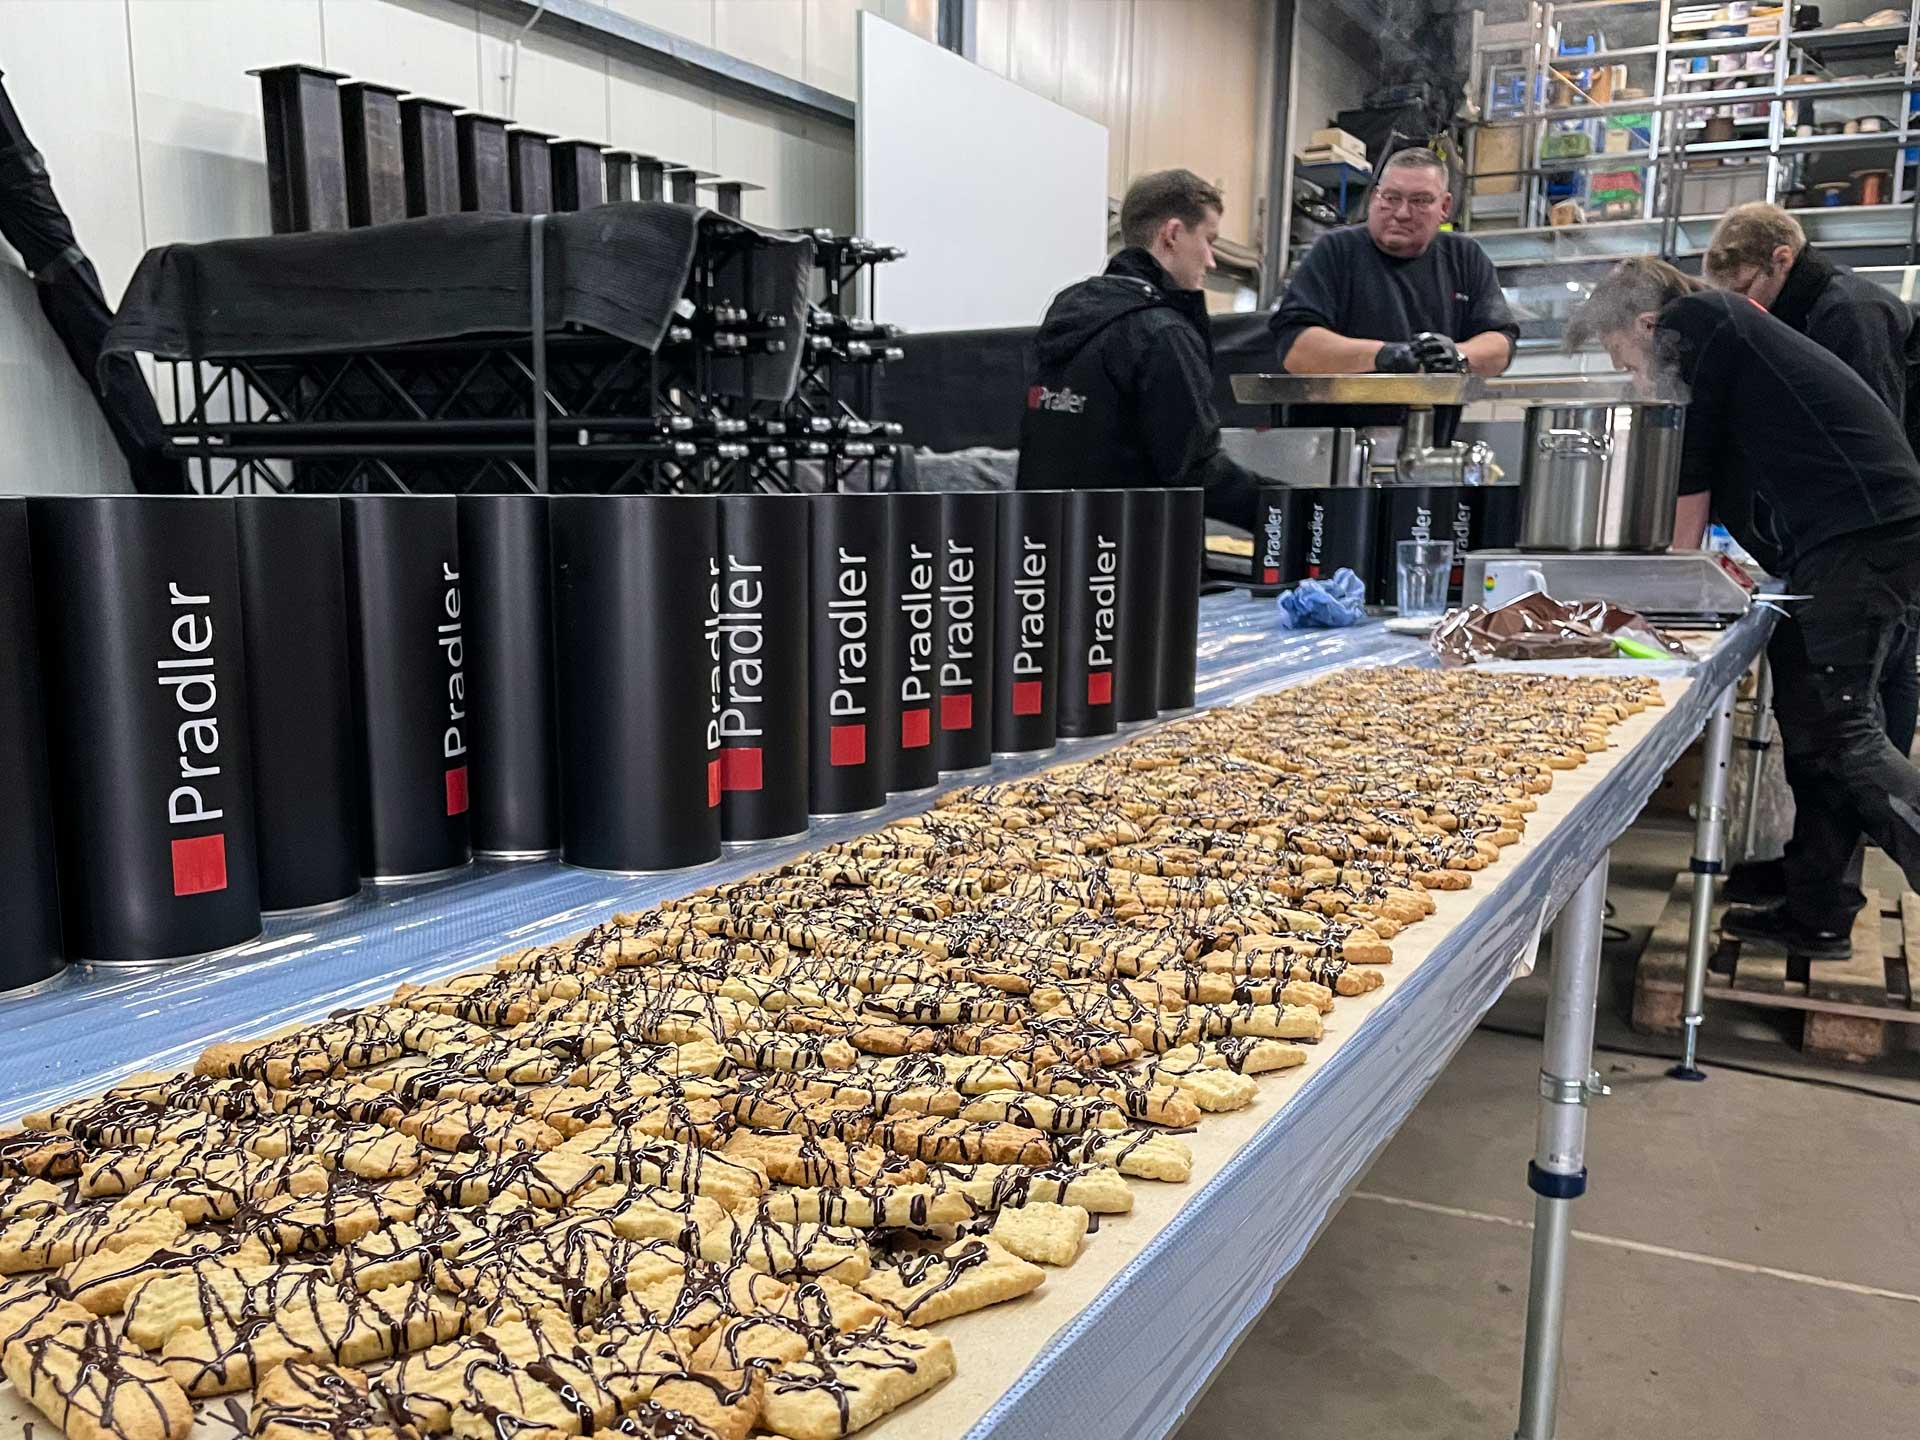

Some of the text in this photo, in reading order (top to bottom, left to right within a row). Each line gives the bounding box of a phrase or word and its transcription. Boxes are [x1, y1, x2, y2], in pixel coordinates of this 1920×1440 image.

[1264, 505, 1282, 567] Pradler
[1309, 502, 1324, 565] Pradler
[1411, 506, 1432, 543] dler
[438, 562, 467, 757] Pradler
[718, 555, 763, 736] Pradler
[828, 547, 867, 716] Pradler
[901, 544, 933, 702] Pradler
[940, 538, 974, 687] Pradler
[1013, 536, 1047, 674] Pradler
[1088, 535, 1117, 666] Pradler
[158, 582, 223, 824] Pradler
